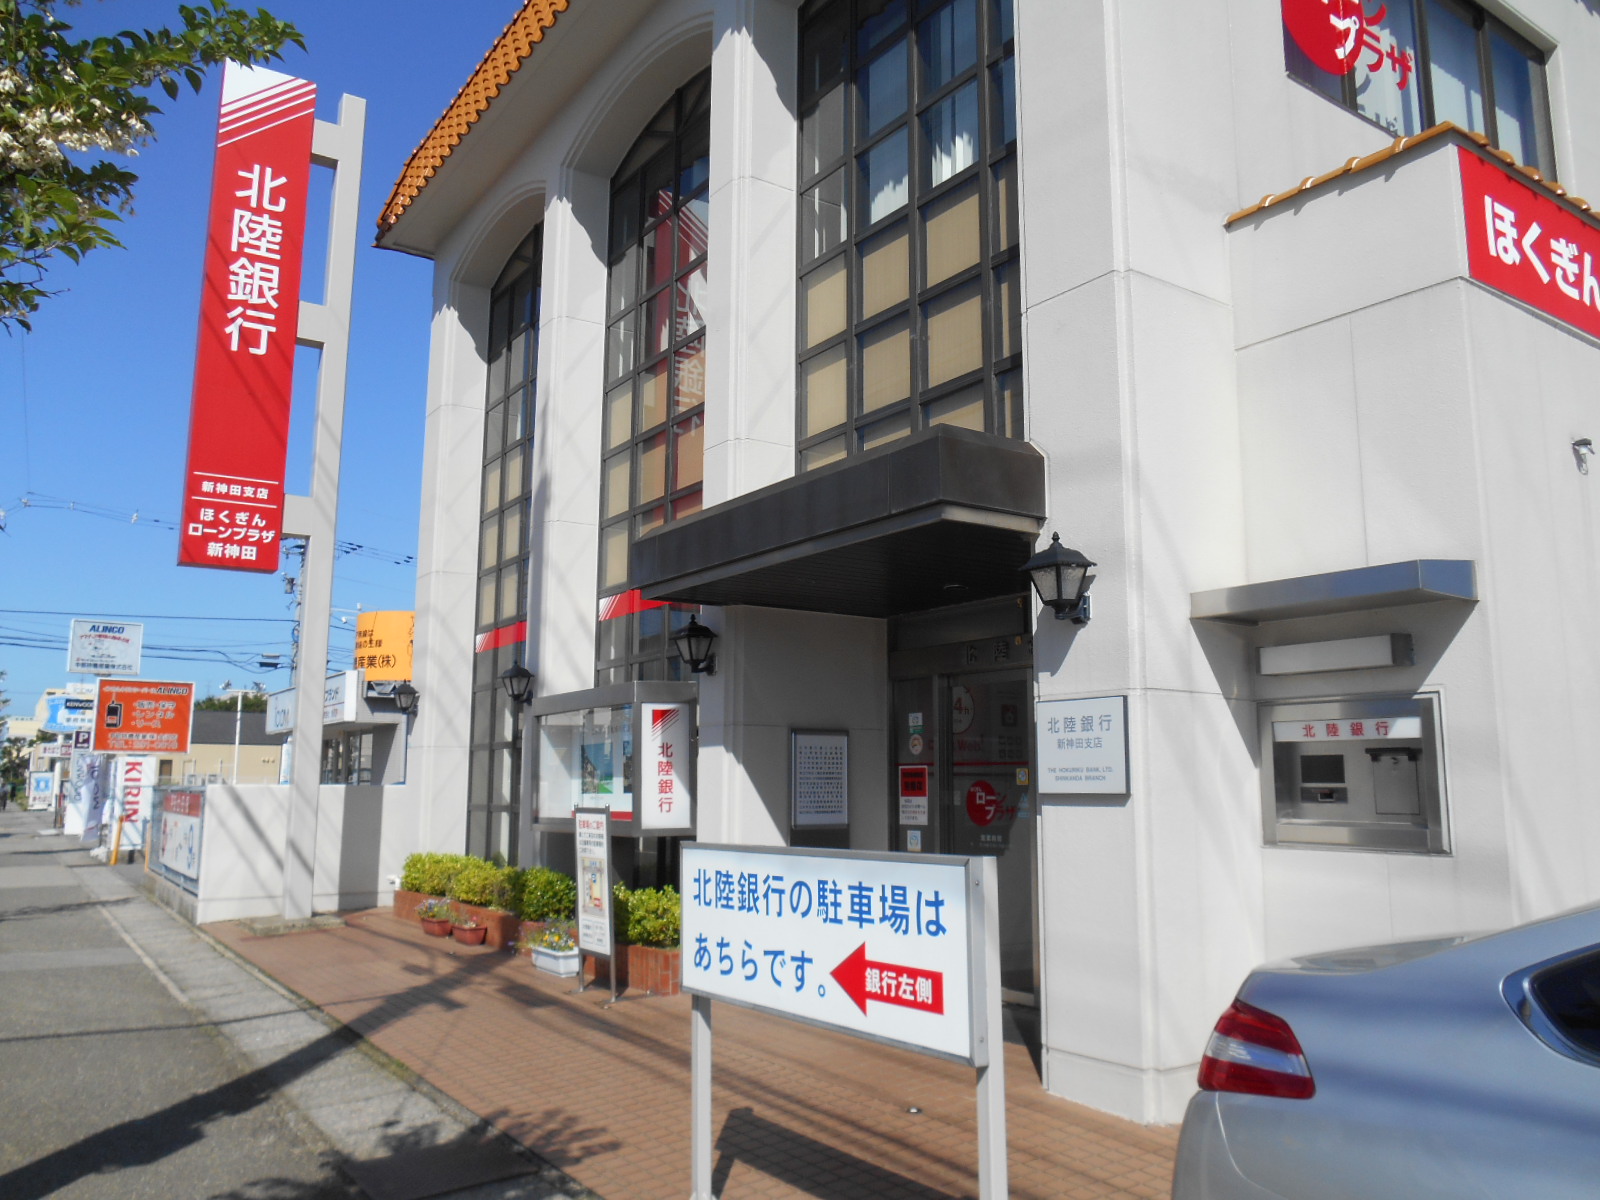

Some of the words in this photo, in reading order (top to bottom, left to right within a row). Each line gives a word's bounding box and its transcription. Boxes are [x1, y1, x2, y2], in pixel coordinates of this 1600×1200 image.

[1329, 13, 1413, 91] プラザ
[224, 163, 288, 356] 北陸銀行
[201, 480, 270, 500] 新神田支店
[200, 507, 267, 528] ほくぎん
[188, 522, 276, 543] ローンプラザ
[206, 541, 258, 561] 新神田
[89, 625, 125, 635] ALINCO
[1047, 714, 1113, 734] 北陸銀行
[1302, 720, 1390, 738] 北陸銀行
[1057, 737, 1103, 750] 新神田支店
[658, 742, 674, 813] 北陸銀行
[124, 761, 143, 823] KIRIN
[692, 868, 947, 938] 北陸銀行の駐車場は
[693, 932, 827, 998] あちらです。
[864, 966, 933, 1005] 銀行左側
